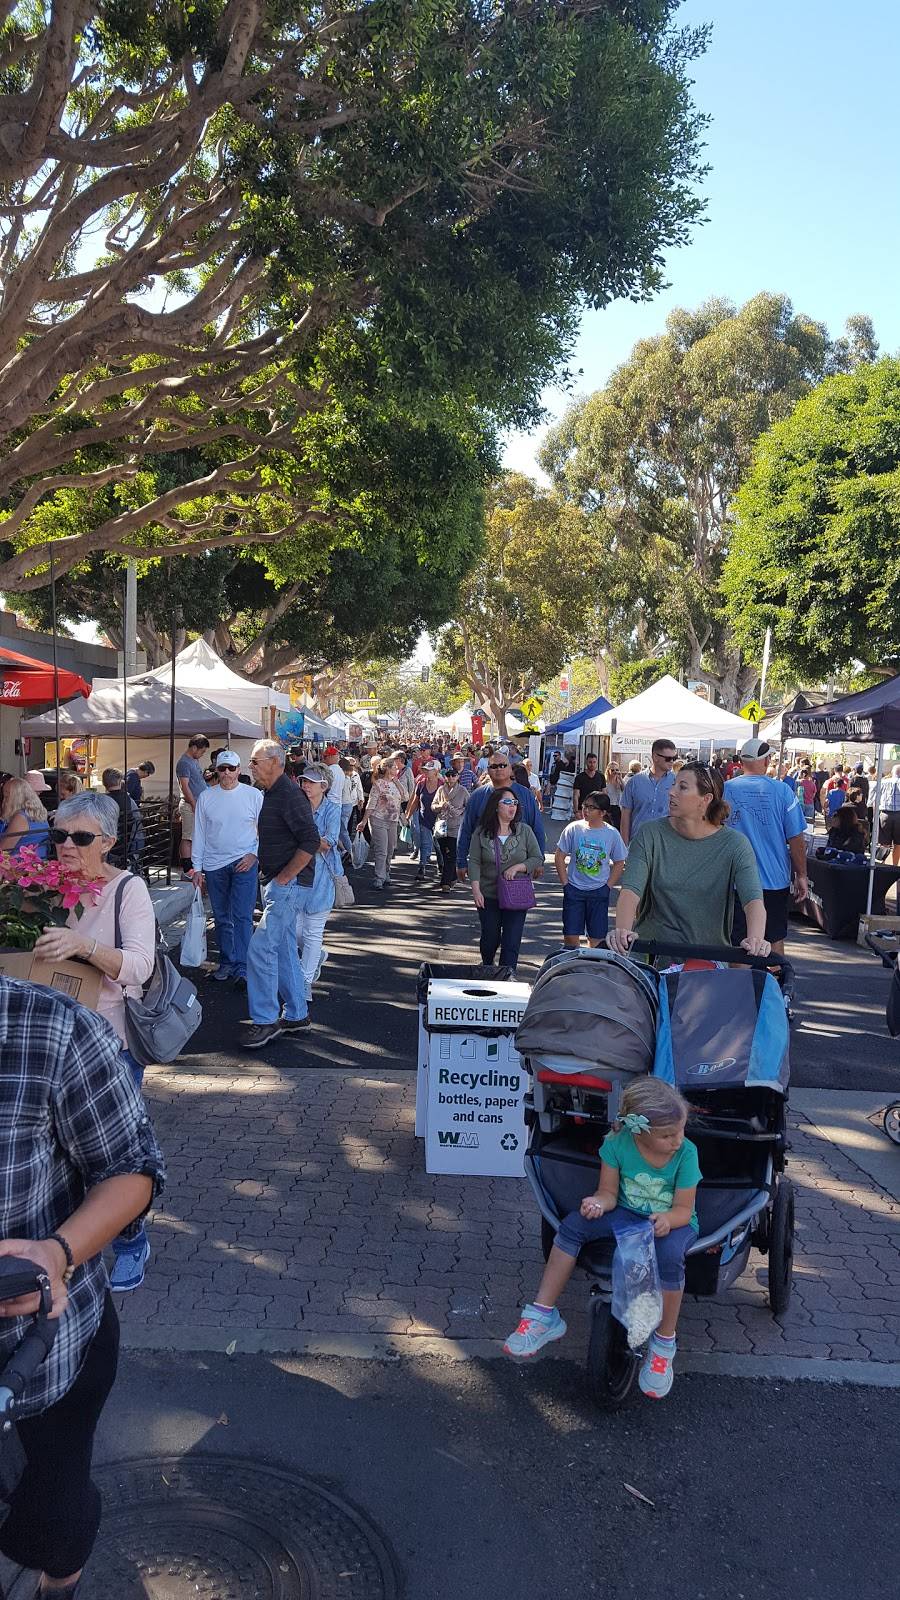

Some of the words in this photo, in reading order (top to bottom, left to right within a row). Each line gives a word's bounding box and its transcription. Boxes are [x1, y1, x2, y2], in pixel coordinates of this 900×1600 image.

[788, 717, 798, 734] The
[799, 718, 809, 735] San
[809, 718, 826, 736] Diego
[826, 715, 873, 735] Union-Tribune
[435, 1007, 489, 1021] RECYCLE
[493, 1009, 524, 1023] HERE
[439, 1068, 520, 1091] Recycling
[438, 1092, 482, 1107] bottles,
[485, 1097, 519, 1109] paper
[453, 1111, 474, 1122] and
[478, 1114, 503, 1123] cans
